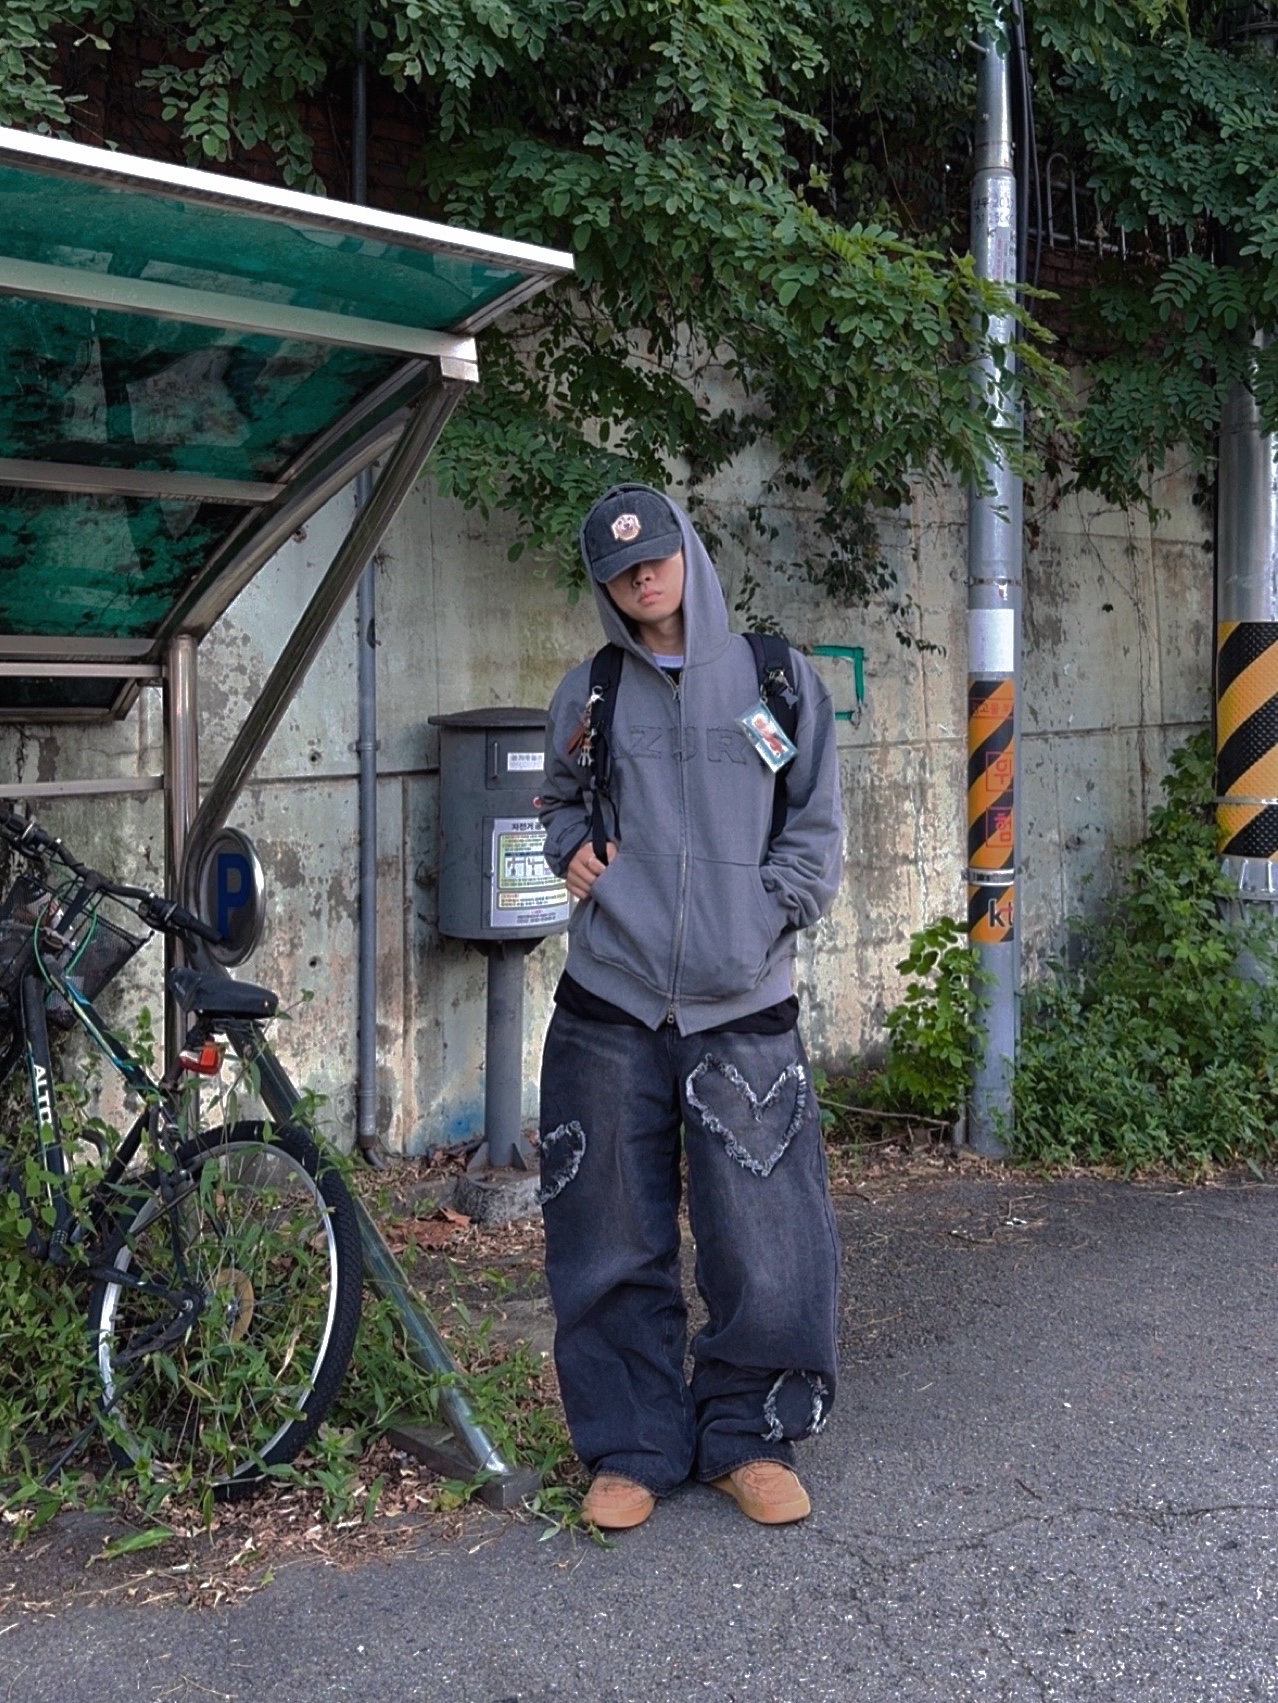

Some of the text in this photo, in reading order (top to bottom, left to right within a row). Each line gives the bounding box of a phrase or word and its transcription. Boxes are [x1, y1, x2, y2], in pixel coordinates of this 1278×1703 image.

[614, 725, 748, 765] ZUR
[217, 853, 251, 940] P
[34, 1064, 56, 1144] ALTO
